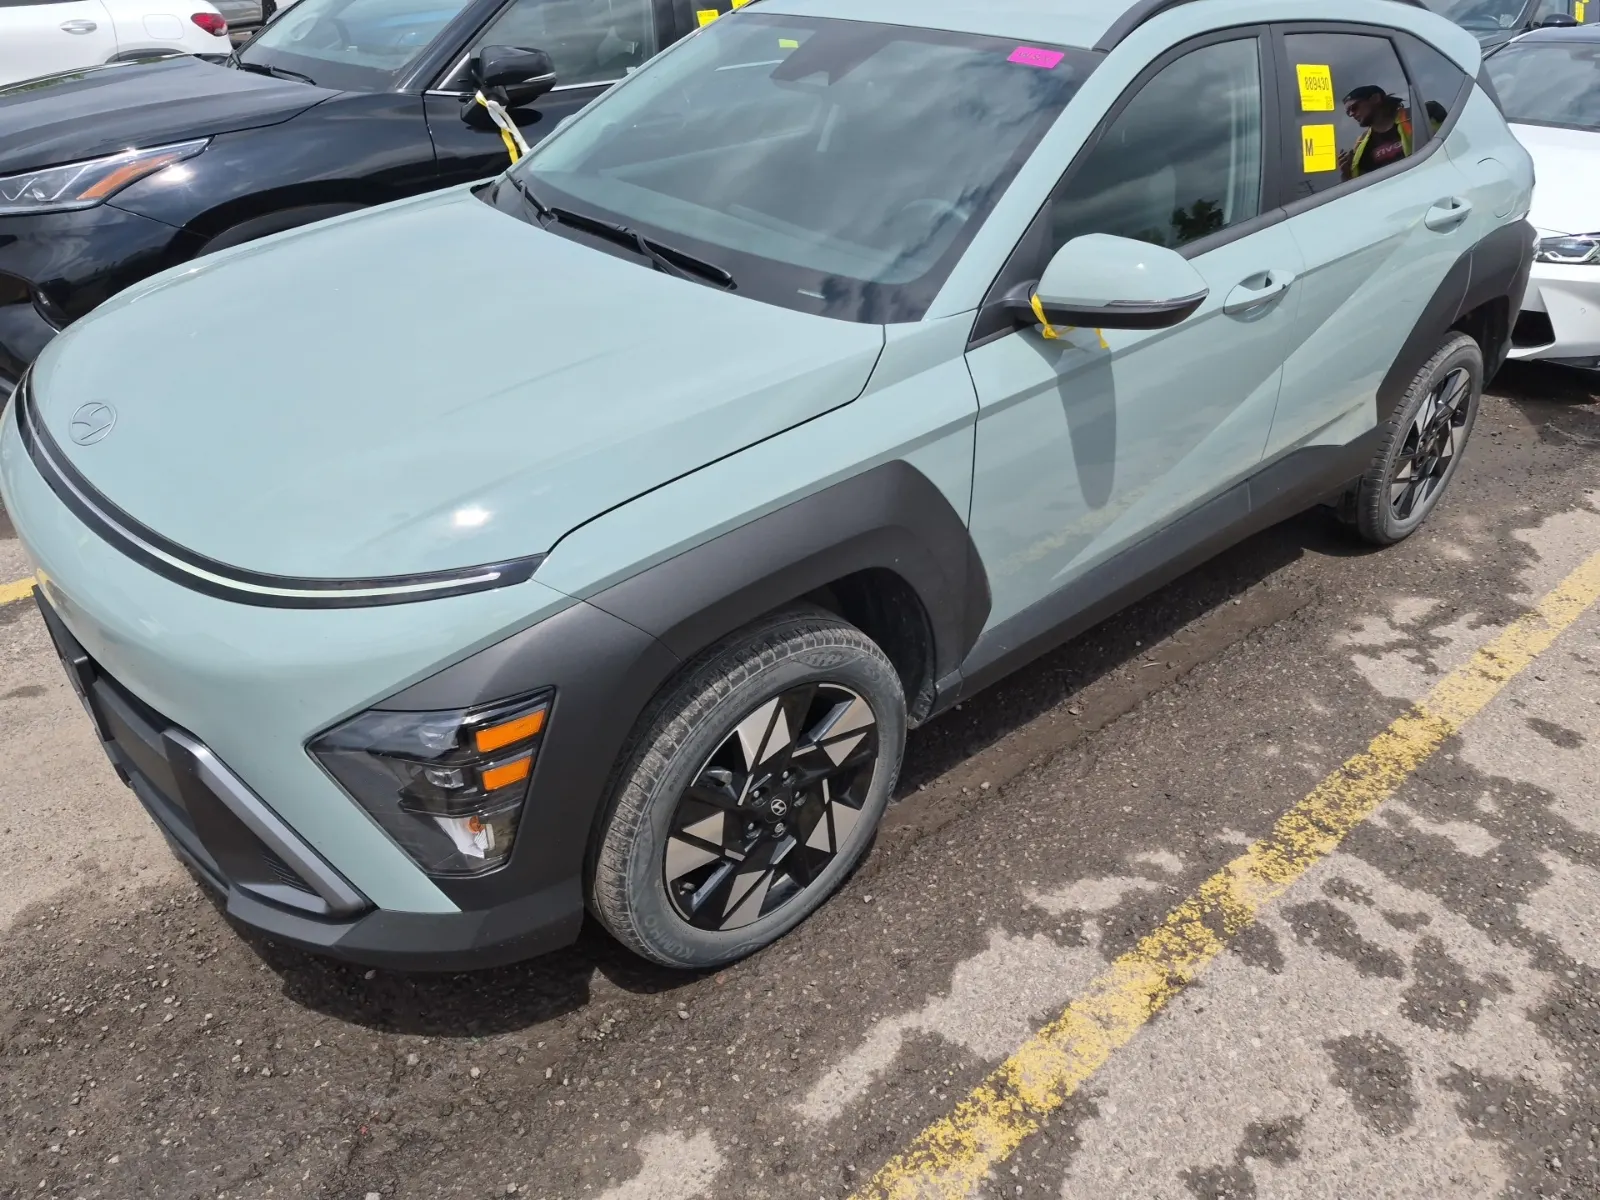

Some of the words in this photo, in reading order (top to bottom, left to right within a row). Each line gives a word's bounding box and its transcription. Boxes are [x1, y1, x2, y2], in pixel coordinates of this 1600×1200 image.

[1304, 76, 1329, 91] 889430
[1305, 138, 1314, 156] M
[644, 915, 696, 960] KUMHO
